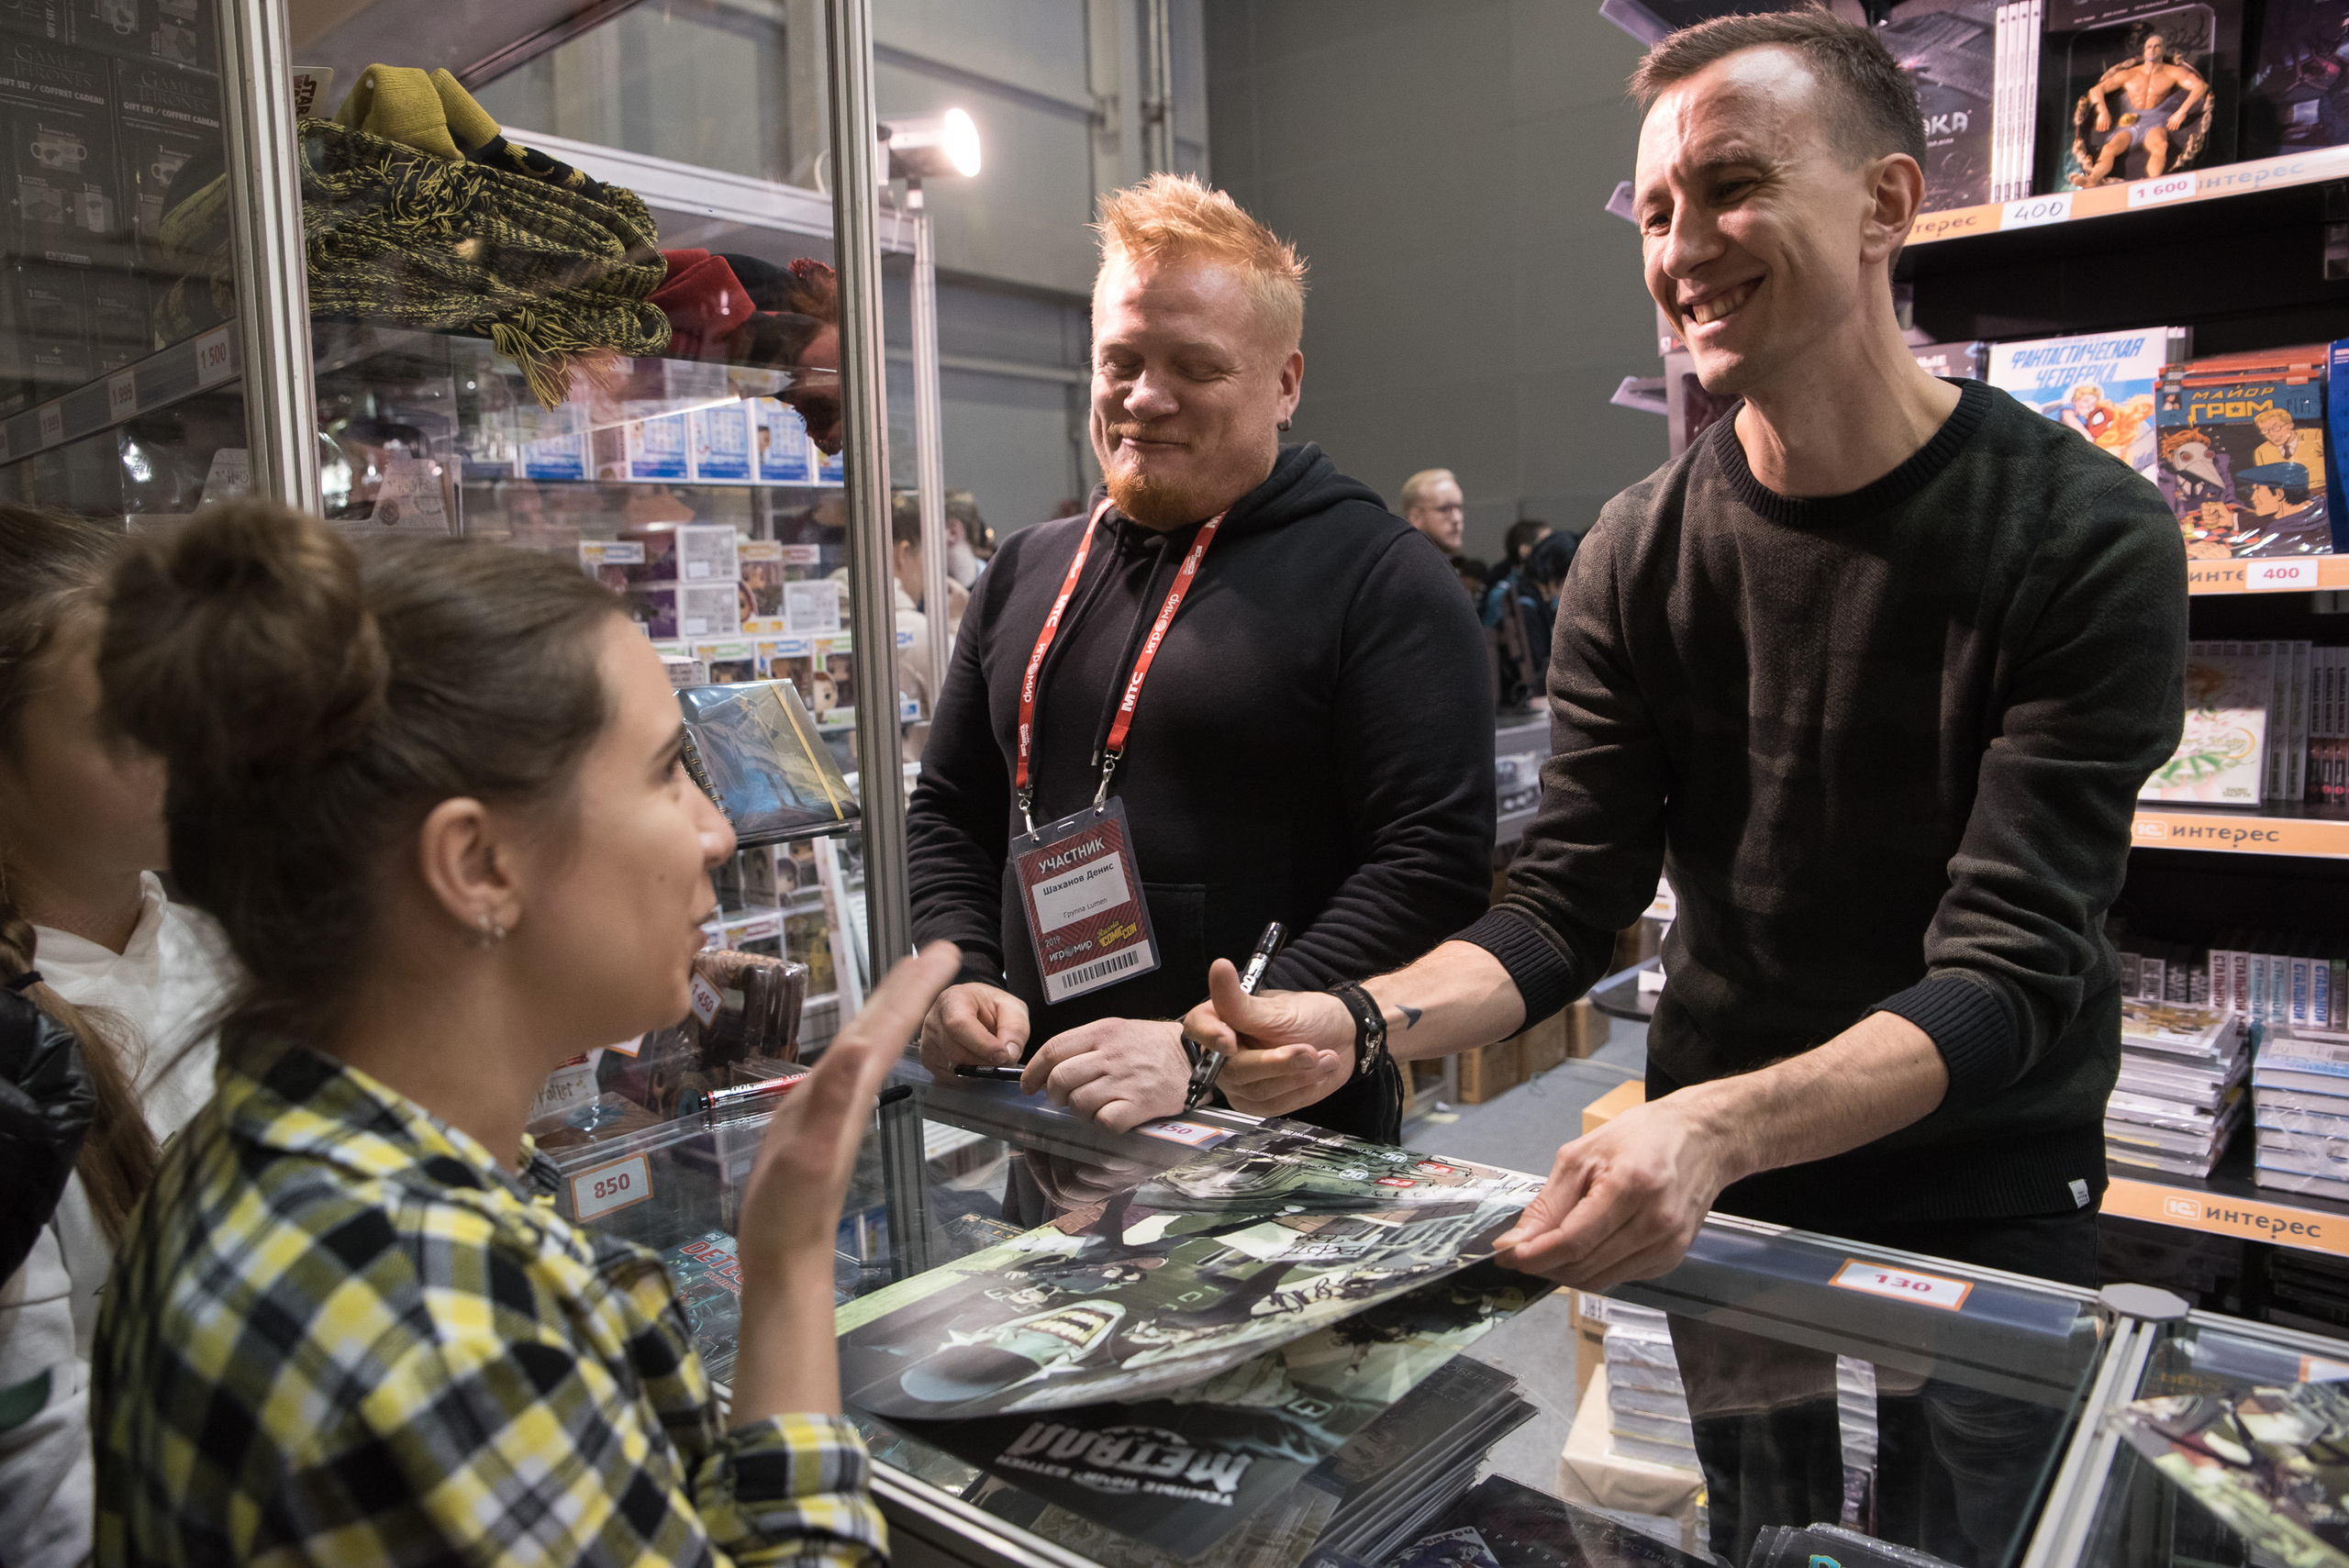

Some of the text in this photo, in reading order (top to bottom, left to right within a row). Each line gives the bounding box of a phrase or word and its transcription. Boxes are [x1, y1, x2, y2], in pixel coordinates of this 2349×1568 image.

[39, 84, 73, 98] COFFRET
[74, 92, 105, 106] CADEAU
[141, 105, 154, 114] SET
[161, 109, 192, 121] COFFRET
[193, 116, 220, 128] CADEAU
[2153, 181, 2189, 197] 600
[2014, 201, 2065, 221] 400
[208, 342, 228, 367] 500
[2011, 338, 2146, 370] ФАНТАСТИЧЕСКАЯ
[118, 384, 133, 404] 999
[2191, 384, 2276, 401] МАЙОР
[2188, 399, 2275, 428] ГРОМ
[2263, 566, 2300, 579] 400
[1047, 594, 1069, 628] МТС
[1121, 672, 1144, 712] МТС
[2172, 825, 2279, 849] интерес
[1038, 836, 1106, 874] УЧАСТНИК
[1042, 862, 1114, 896] Шаханов Денис
[1063, 897, 1108, 919] Группа Lumen
[1097, 919, 1120, 938] Russia
[1044, 936, 1061, 948] 2019
[697, 991, 714, 1013] 450
[730, 1084, 752, 1095] 100
[1156, 1122, 1193, 1136] 150
[1340, 1169, 1367, 1181] DC
[594, 1173, 630, 1200] 850
[2206, 1206, 2322, 1240] интерес
[1874, 1273, 1932, 1295] 130
[1445, 1362, 1496, 1385] ОБЕРТ
[1005, 1421, 1253, 1494] МЕТАЛЛ
